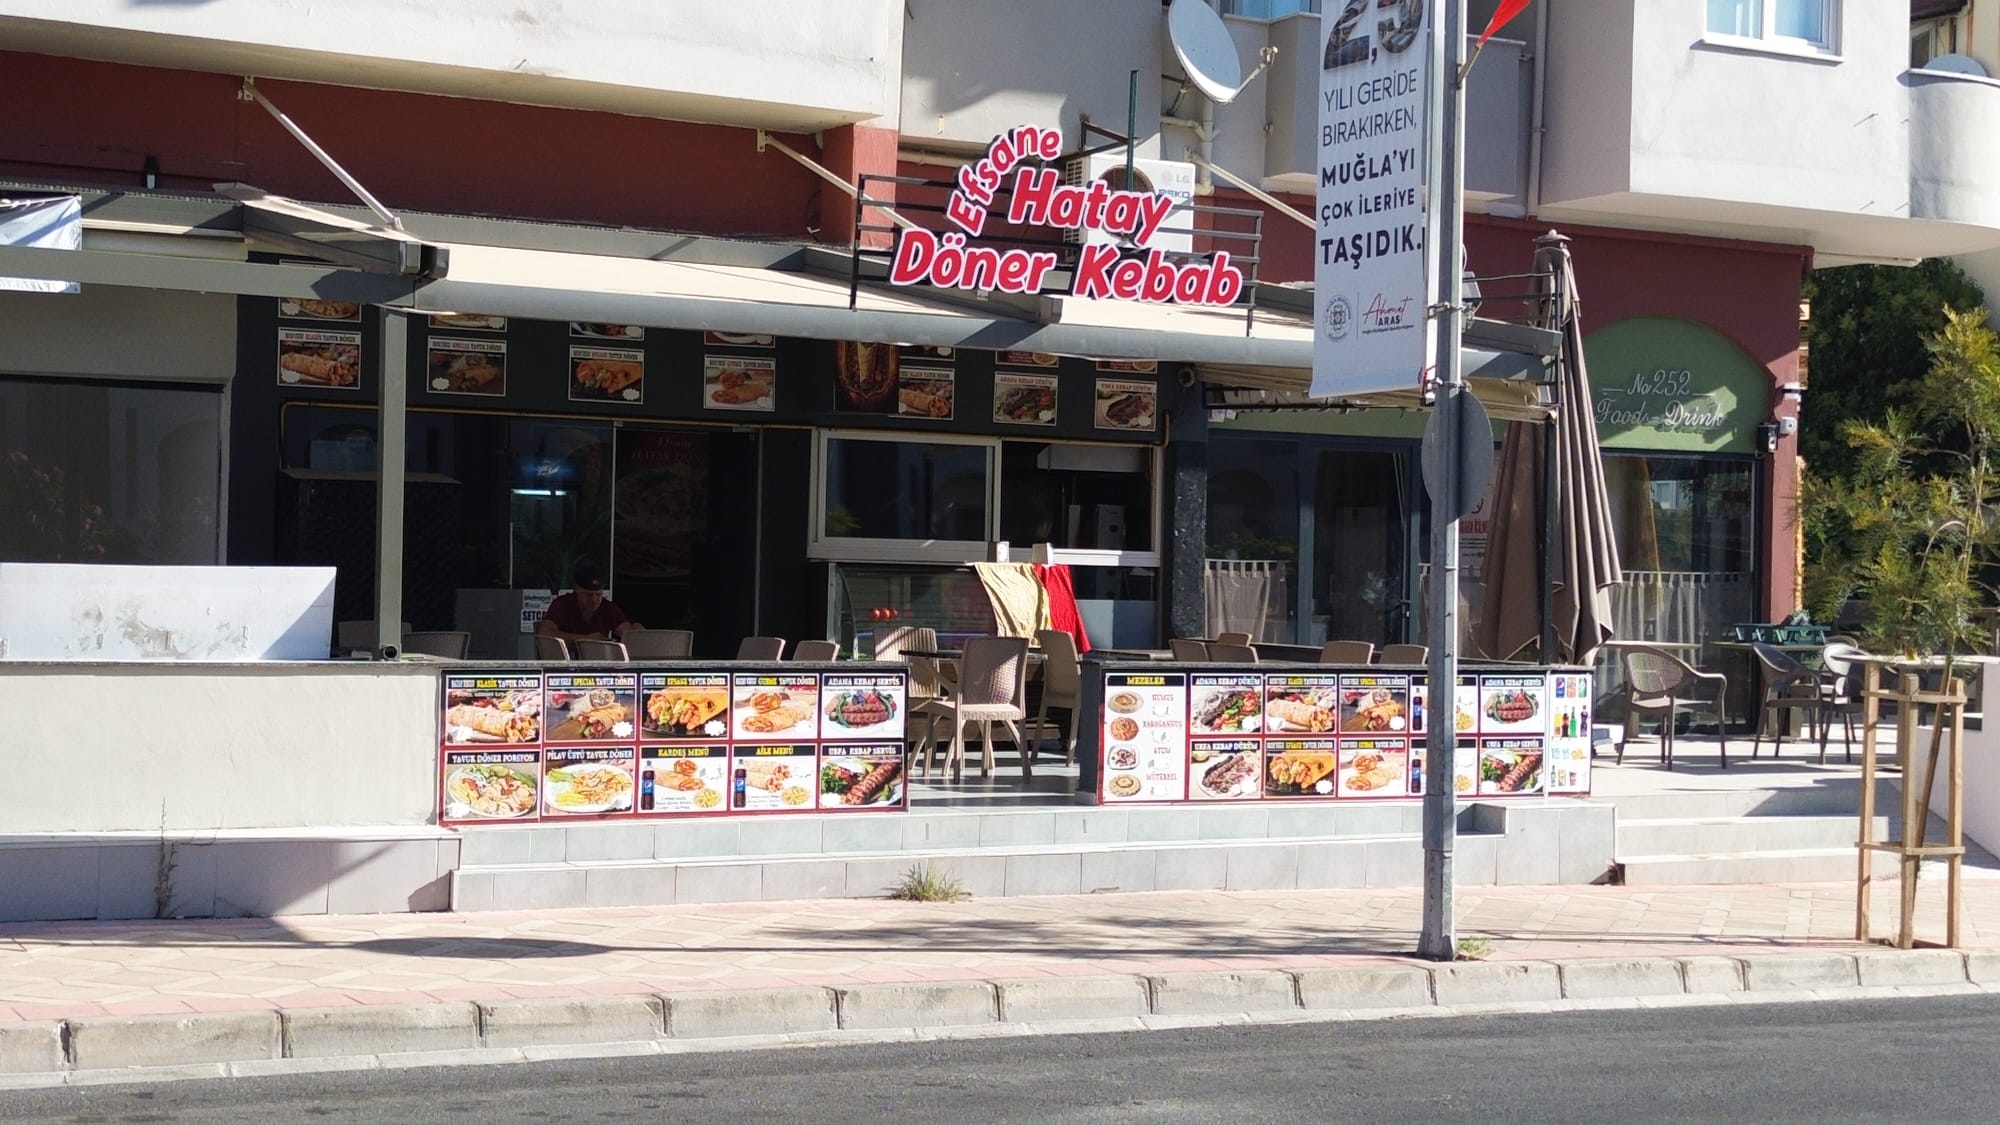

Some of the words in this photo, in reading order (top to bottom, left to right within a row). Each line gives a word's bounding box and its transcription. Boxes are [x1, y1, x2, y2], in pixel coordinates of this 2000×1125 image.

[1324, 86, 1353, 112] YILI
[1357, 69, 1417, 105] GERİDE
[1322, 105, 1417, 147] BIRAKIRKEN,
[947, 126, 1062, 237] Efsane
[1321, 147, 1415, 188] MUĞLA'YI
[1008, 167, 1173, 245] Hatay
[1321, 200, 1353, 227] ÇOK
[1359, 187, 1415, 215] İLERİYE
[889, 227, 1057, 297] Döner
[1072, 243, 1244, 306] Kebab
[1320, 223, 1422, 270] TAŞIDIK.
[1378, 315, 1401, 326] ARAS
[1663, 400, 1725, 427] Drink
[477, 752, 502, 763] DÖNER
